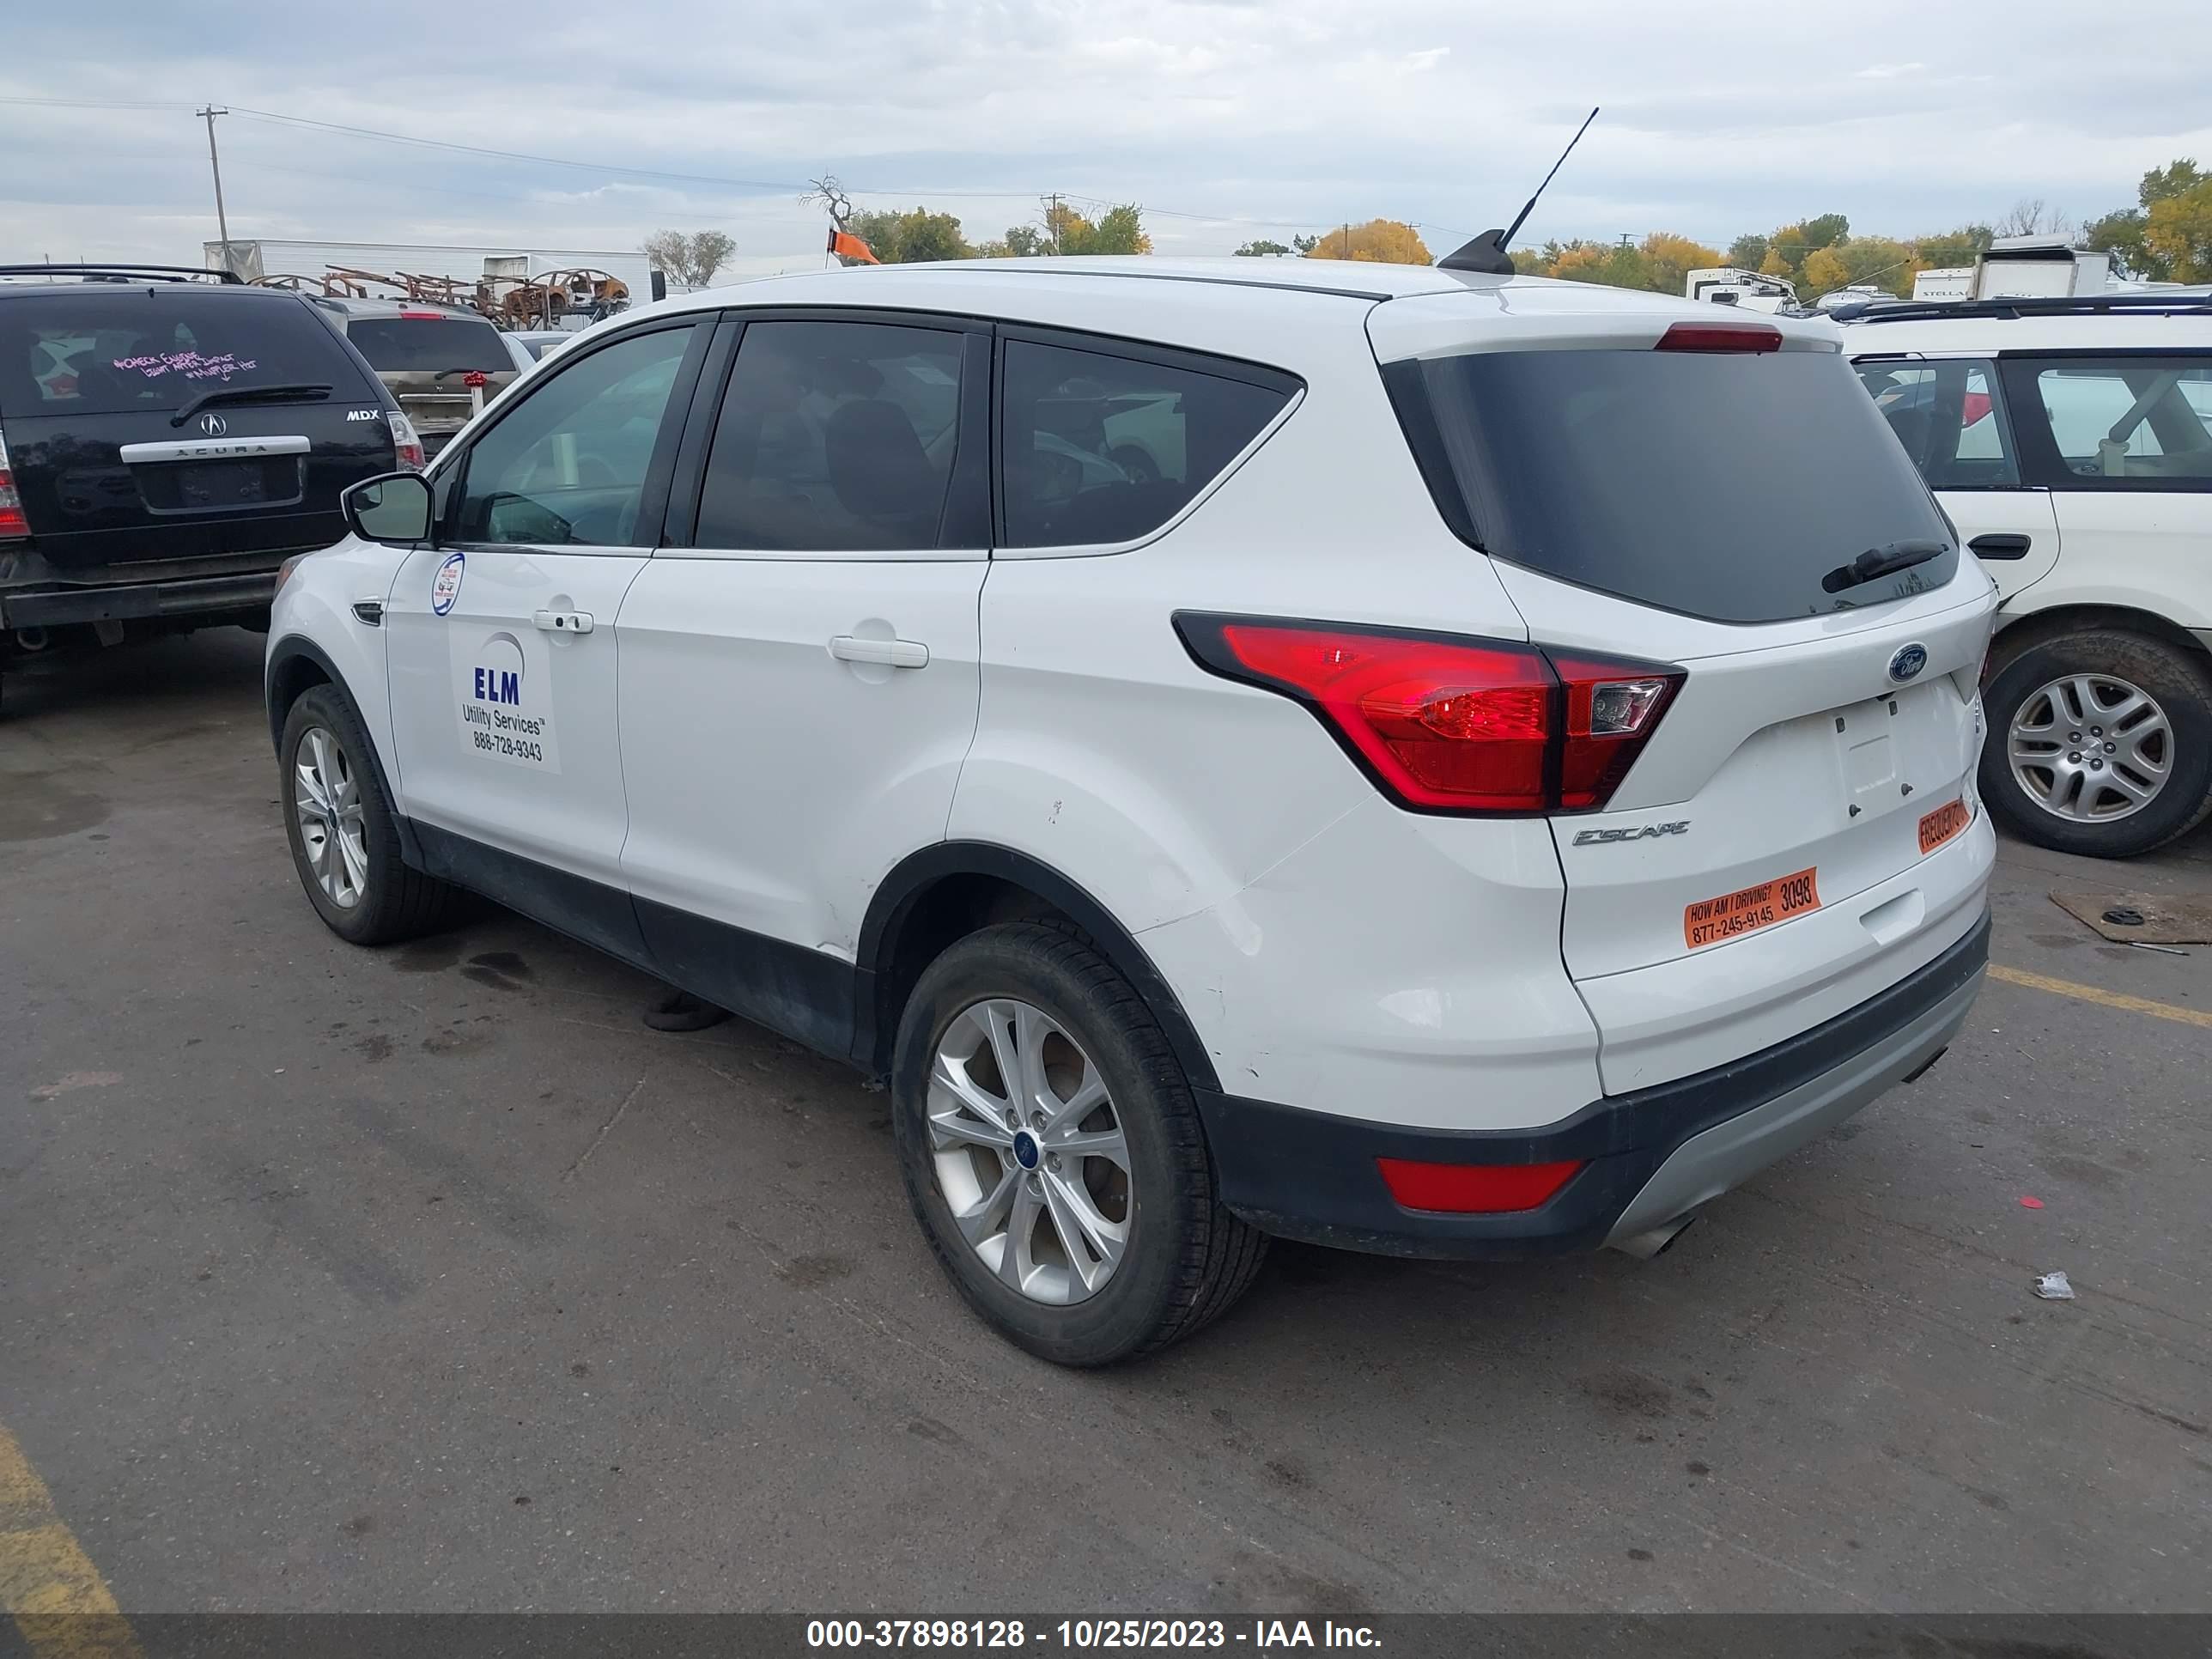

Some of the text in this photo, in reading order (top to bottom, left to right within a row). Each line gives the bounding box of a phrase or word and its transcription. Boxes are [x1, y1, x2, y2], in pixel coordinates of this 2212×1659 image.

[346, 410, 380, 422] MDX
[176, 445, 268, 457] ACURA
[474, 666, 520, 706] ELM
[462, 703, 491, 731] Utility
[473, 730, 543, 763] 888-728-9343
[1571, 819, 1692, 846] ESCAPE
[1690, 903, 1713, 923] HOW
[1713, 899, 1729, 917] AM
[1735, 884, 1772, 910] DRIVING?
[1779, 875, 1813, 912] 3098
[1692, 905, 1774, 944] 877-245-9145
